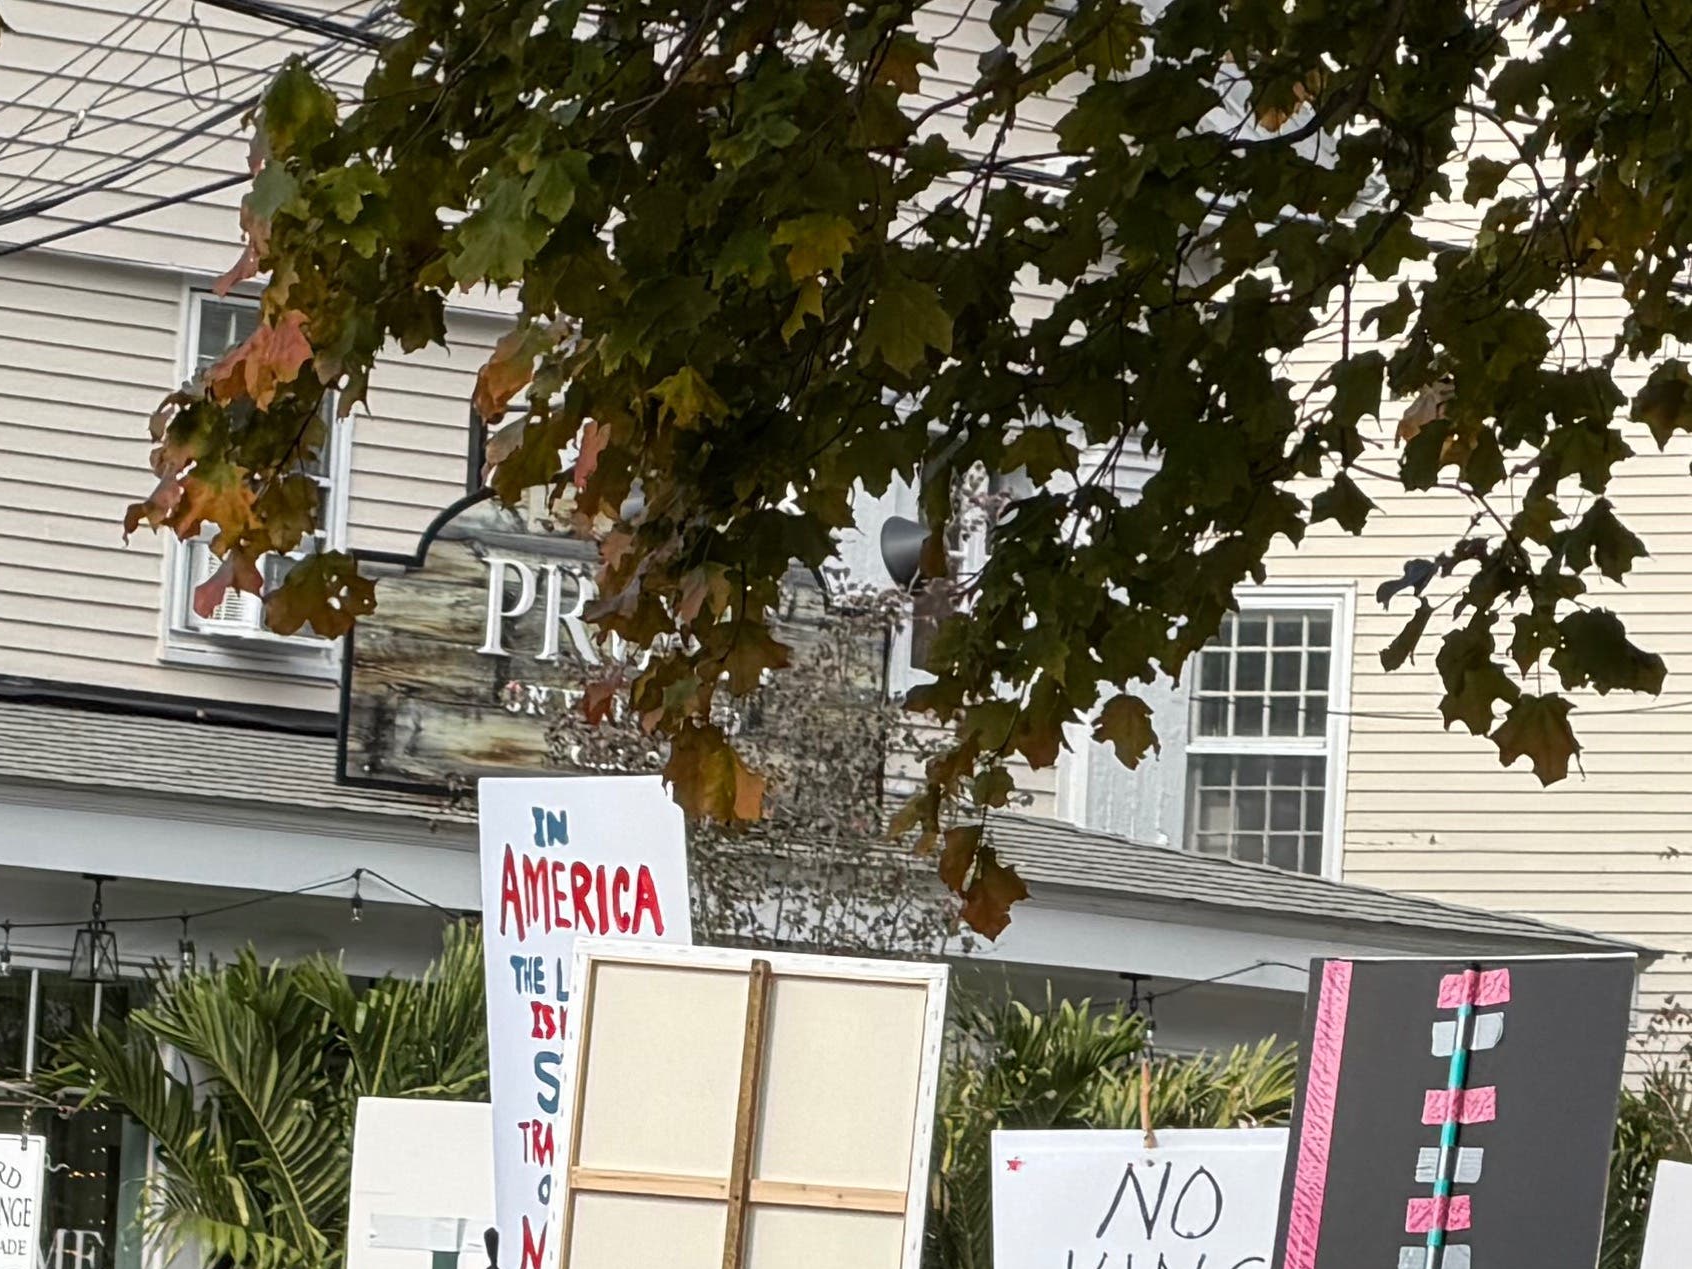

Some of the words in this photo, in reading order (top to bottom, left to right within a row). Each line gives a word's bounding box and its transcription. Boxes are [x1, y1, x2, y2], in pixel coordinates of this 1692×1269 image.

[532, 806, 569, 847] IN
[500, 843, 664, 942] AMERICA
[510, 955, 546, 995] THE
[531, 1001, 557, 1040] IS
[1095, 1161, 1223, 1240] NO
